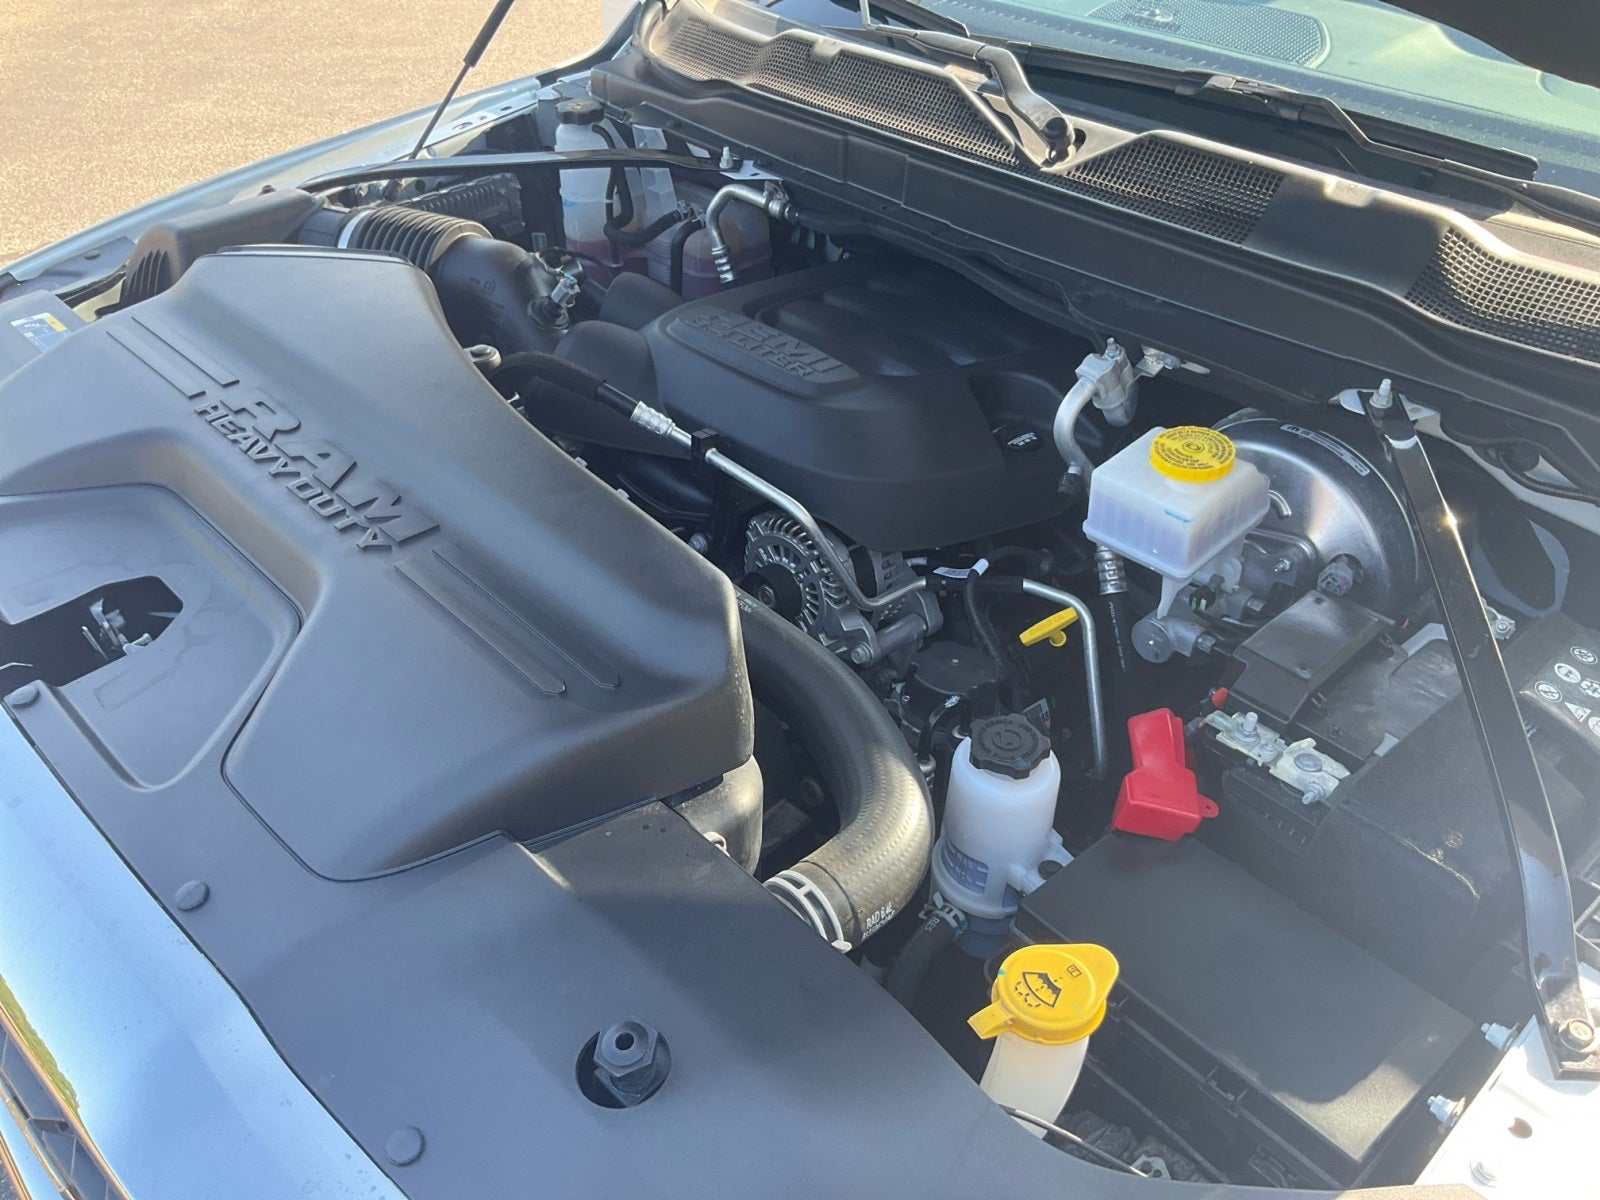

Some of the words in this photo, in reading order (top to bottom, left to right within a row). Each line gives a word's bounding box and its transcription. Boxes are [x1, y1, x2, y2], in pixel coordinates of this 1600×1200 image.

[699, 309, 845, 373] HEMI
[728, 333, 815, 377] LITER
[194, 401, 301, 477] HEAVY
[285, 477, 393, 551] DUTY
[219, 386, 441, 543] RAM
[866, 910, 880, 930] RAD
